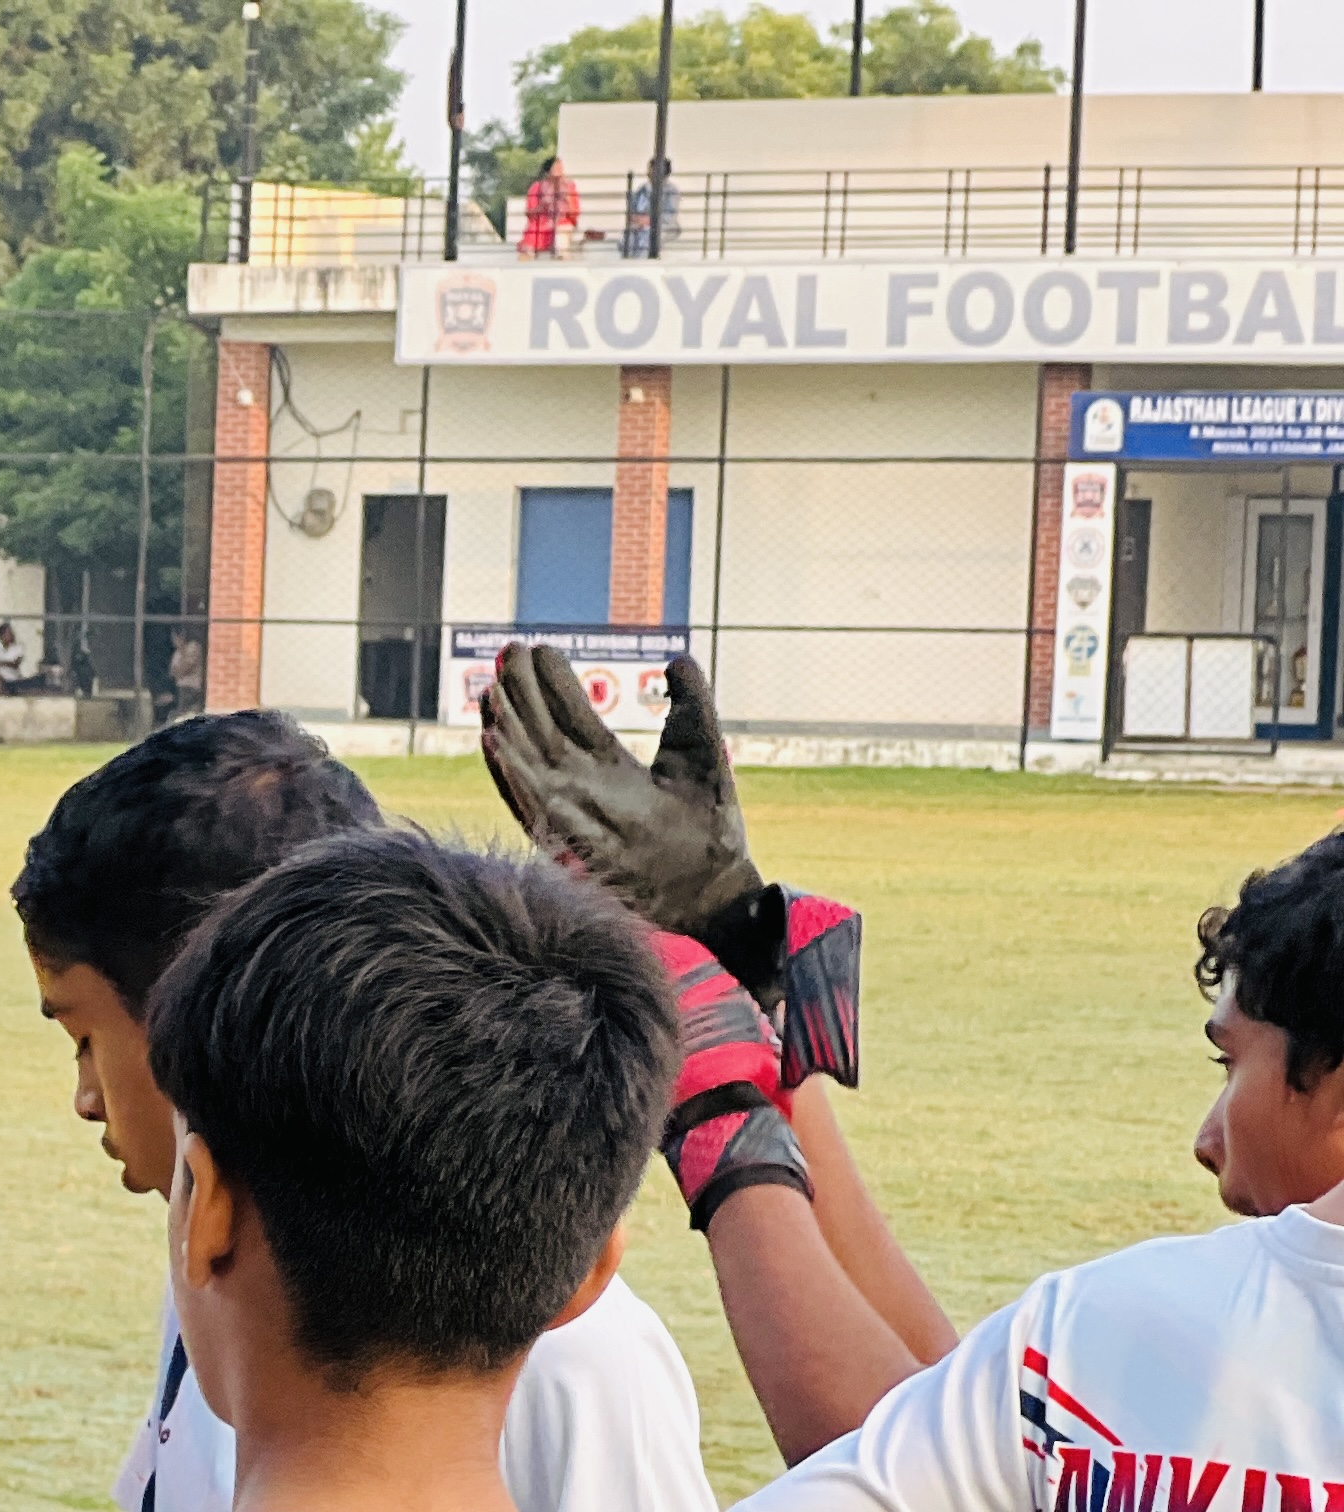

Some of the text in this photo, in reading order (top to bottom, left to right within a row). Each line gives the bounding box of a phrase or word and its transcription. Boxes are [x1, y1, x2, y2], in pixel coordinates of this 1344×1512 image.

[529, 270, 1344, 350] ROYAL FOOTBAL
[1130, 397, 1228, 423] RAJASTHAN
[1230, 398, 1296, 424] LEAGUE
